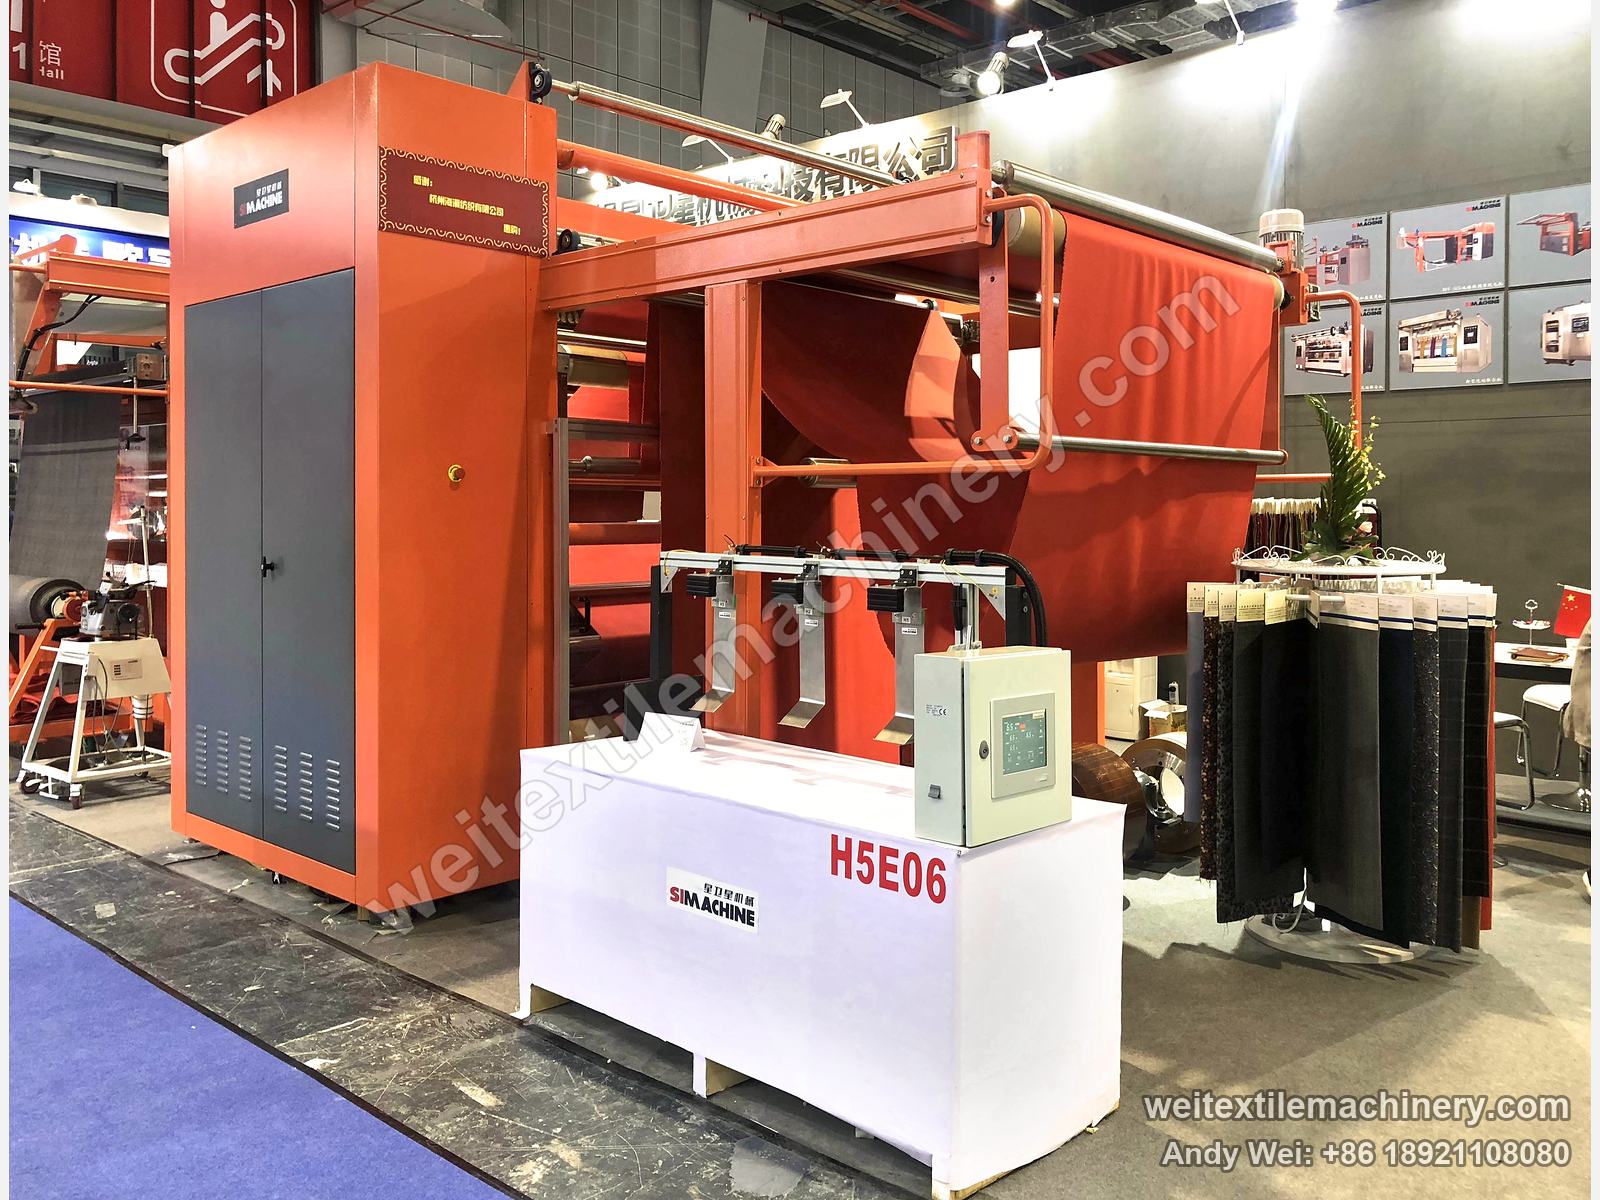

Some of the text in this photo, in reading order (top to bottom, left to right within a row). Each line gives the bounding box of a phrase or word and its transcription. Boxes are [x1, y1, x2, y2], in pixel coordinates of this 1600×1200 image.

[39, 41, 62, 66] 馆
[830, 833, 947, 905] H5E06
[669, 886, 755, 927] SIMACHINE
[704, 883, 755, 908] 星卫星机械
